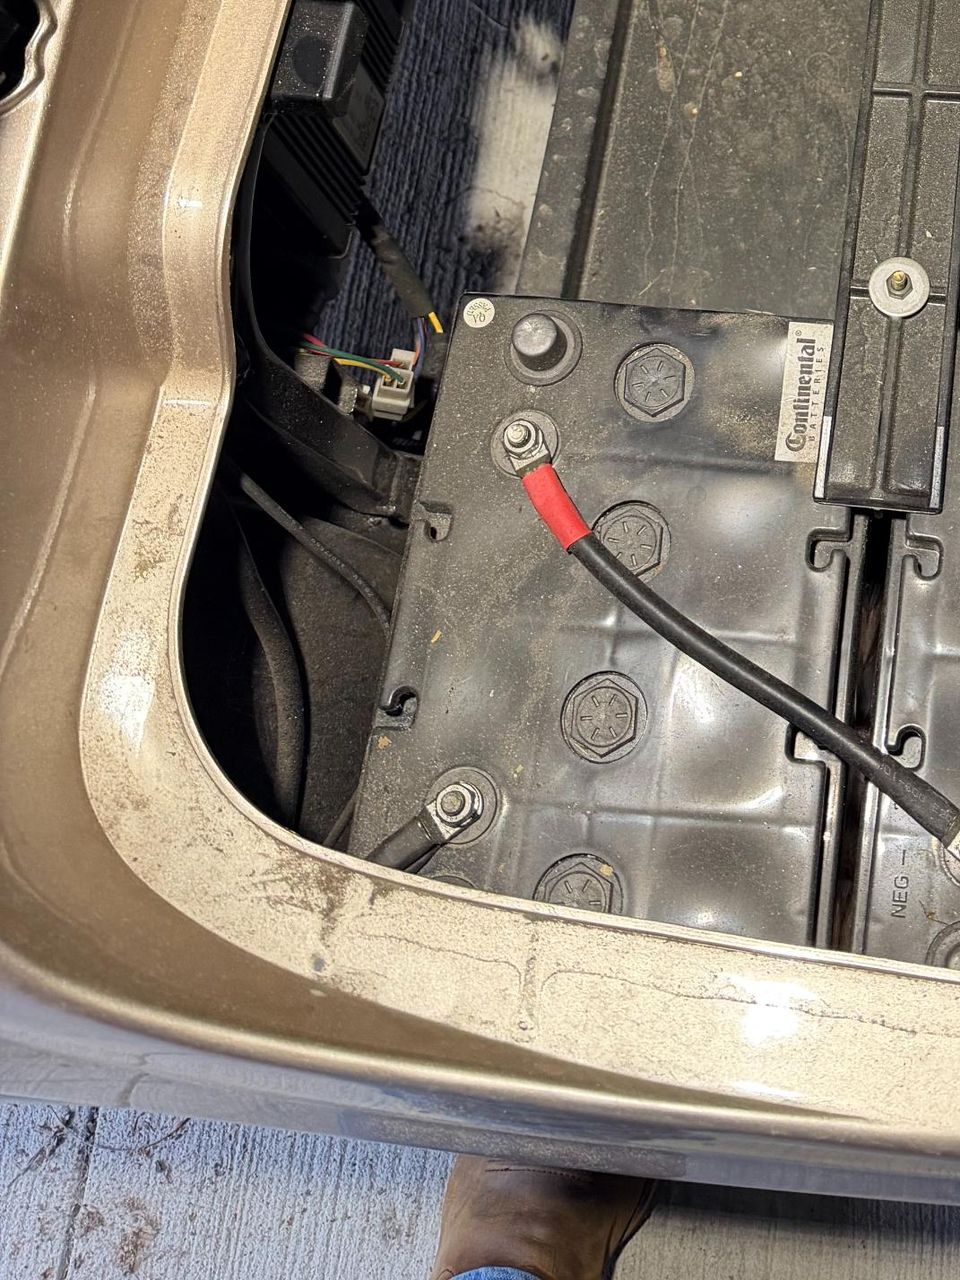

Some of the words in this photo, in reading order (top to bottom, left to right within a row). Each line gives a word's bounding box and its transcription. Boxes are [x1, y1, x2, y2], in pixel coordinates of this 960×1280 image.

[785, 338, 815, 451] Continental
[807, 346, 824, 441] BATTERIES
[890, 876, 909, 919] NEG
